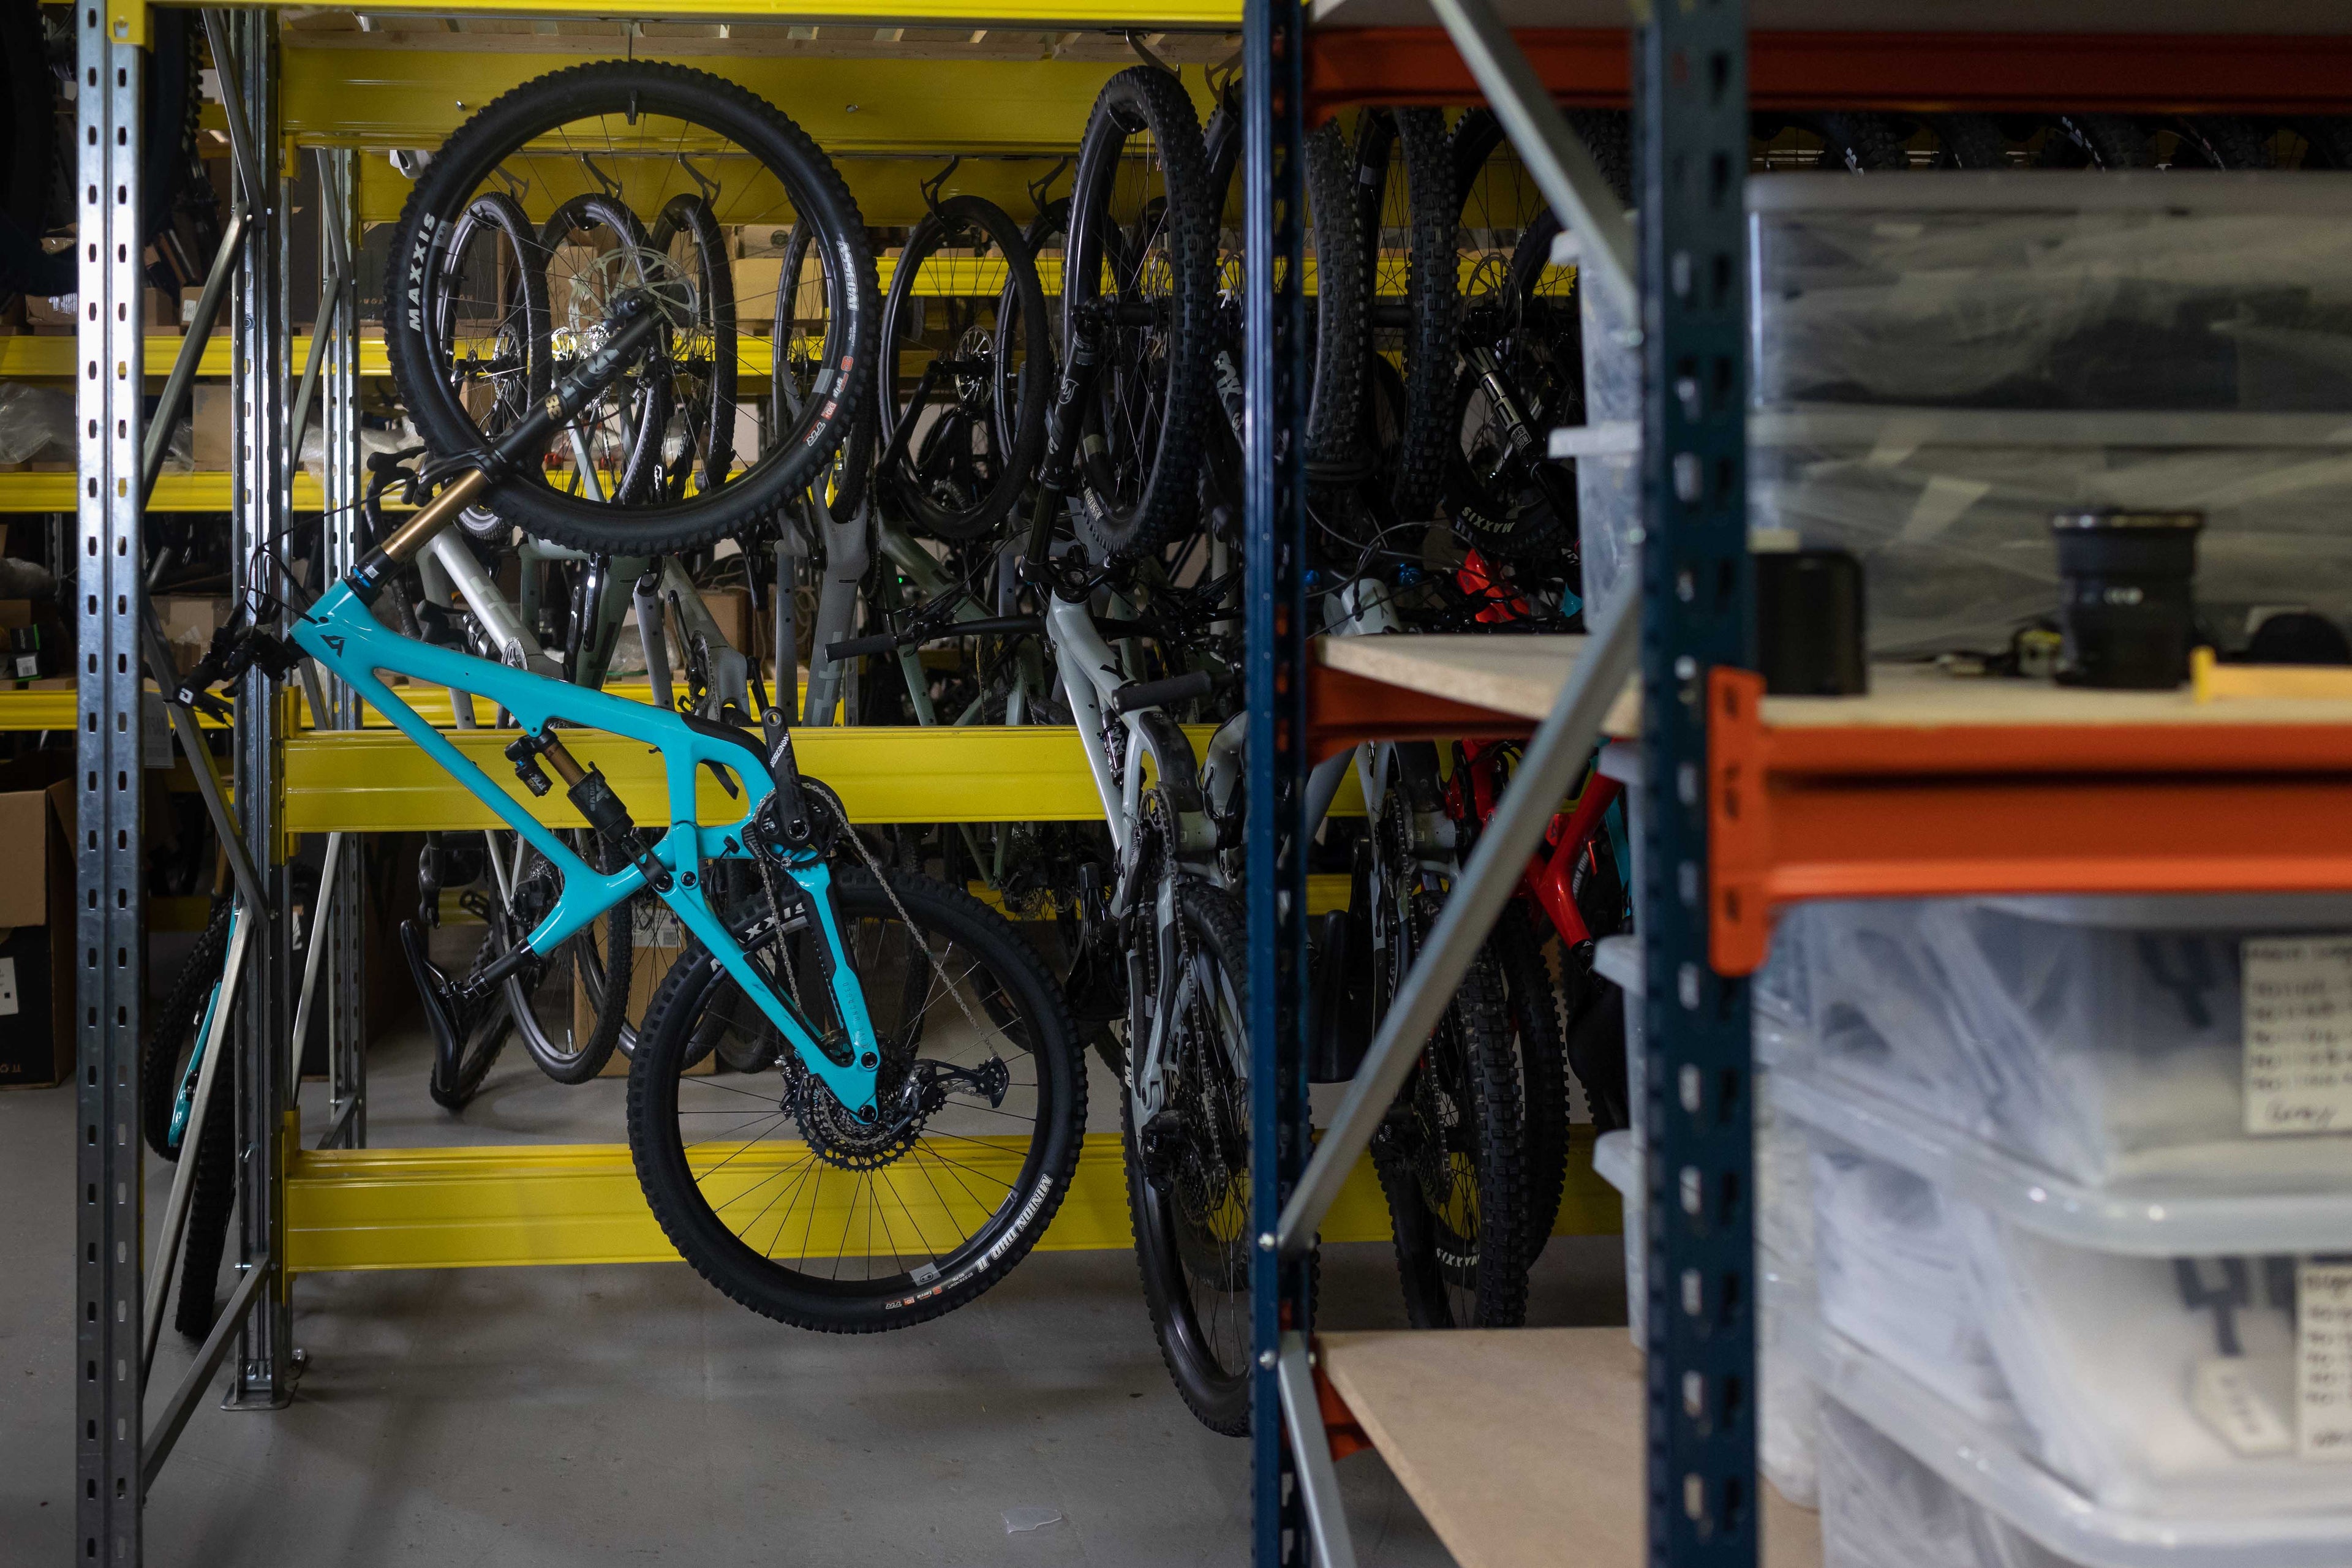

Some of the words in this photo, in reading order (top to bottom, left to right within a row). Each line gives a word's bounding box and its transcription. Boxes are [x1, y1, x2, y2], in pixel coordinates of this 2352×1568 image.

[408, 212, 435, 333] MAXXIS
[836, 241, 859, 311] ASSEGAI
[1214, 350, 1243, 410] FOX
[806, 421, 826, 447] TR
[1461, 506, 1516, 534] MAXXIS
[1014, 1173, 1053, 1232] MINION
[989, 1227, 1019, 1260] DHR
